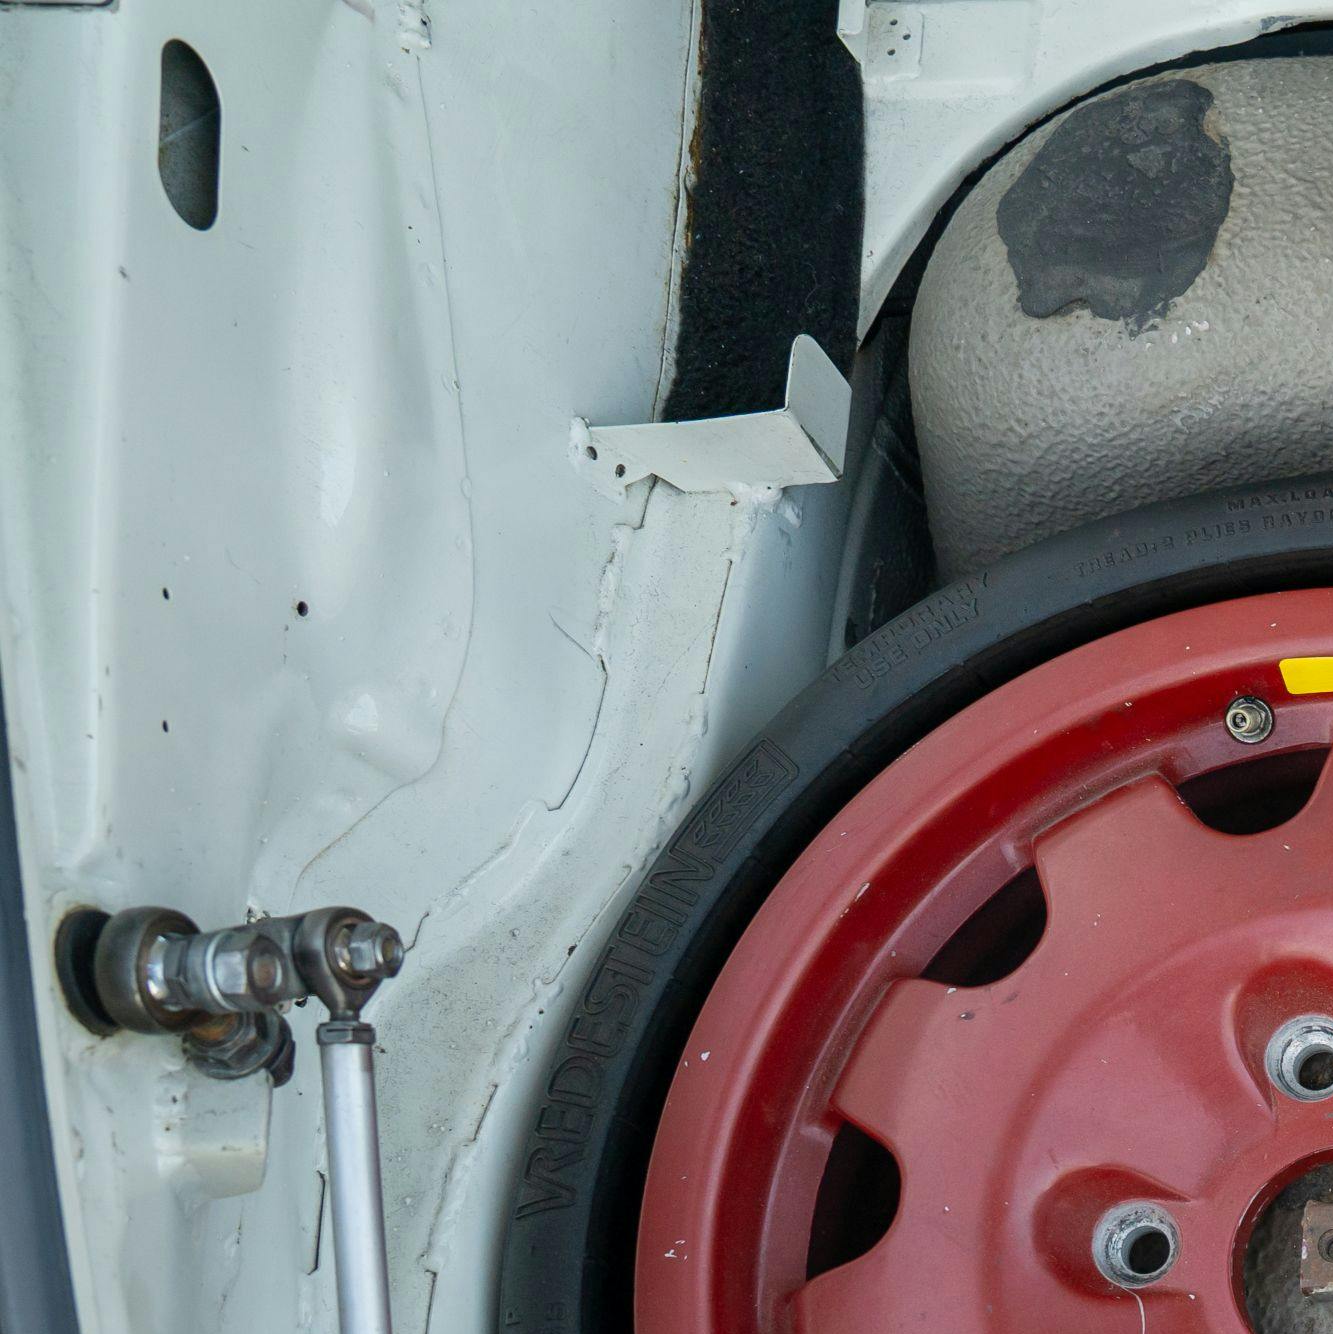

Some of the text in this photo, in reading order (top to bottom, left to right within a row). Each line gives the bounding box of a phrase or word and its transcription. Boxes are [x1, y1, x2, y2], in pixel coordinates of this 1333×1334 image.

[847, 594, 988, 692] USE ONLY
[512, 839, 720, 1224] VREDESTEIN
